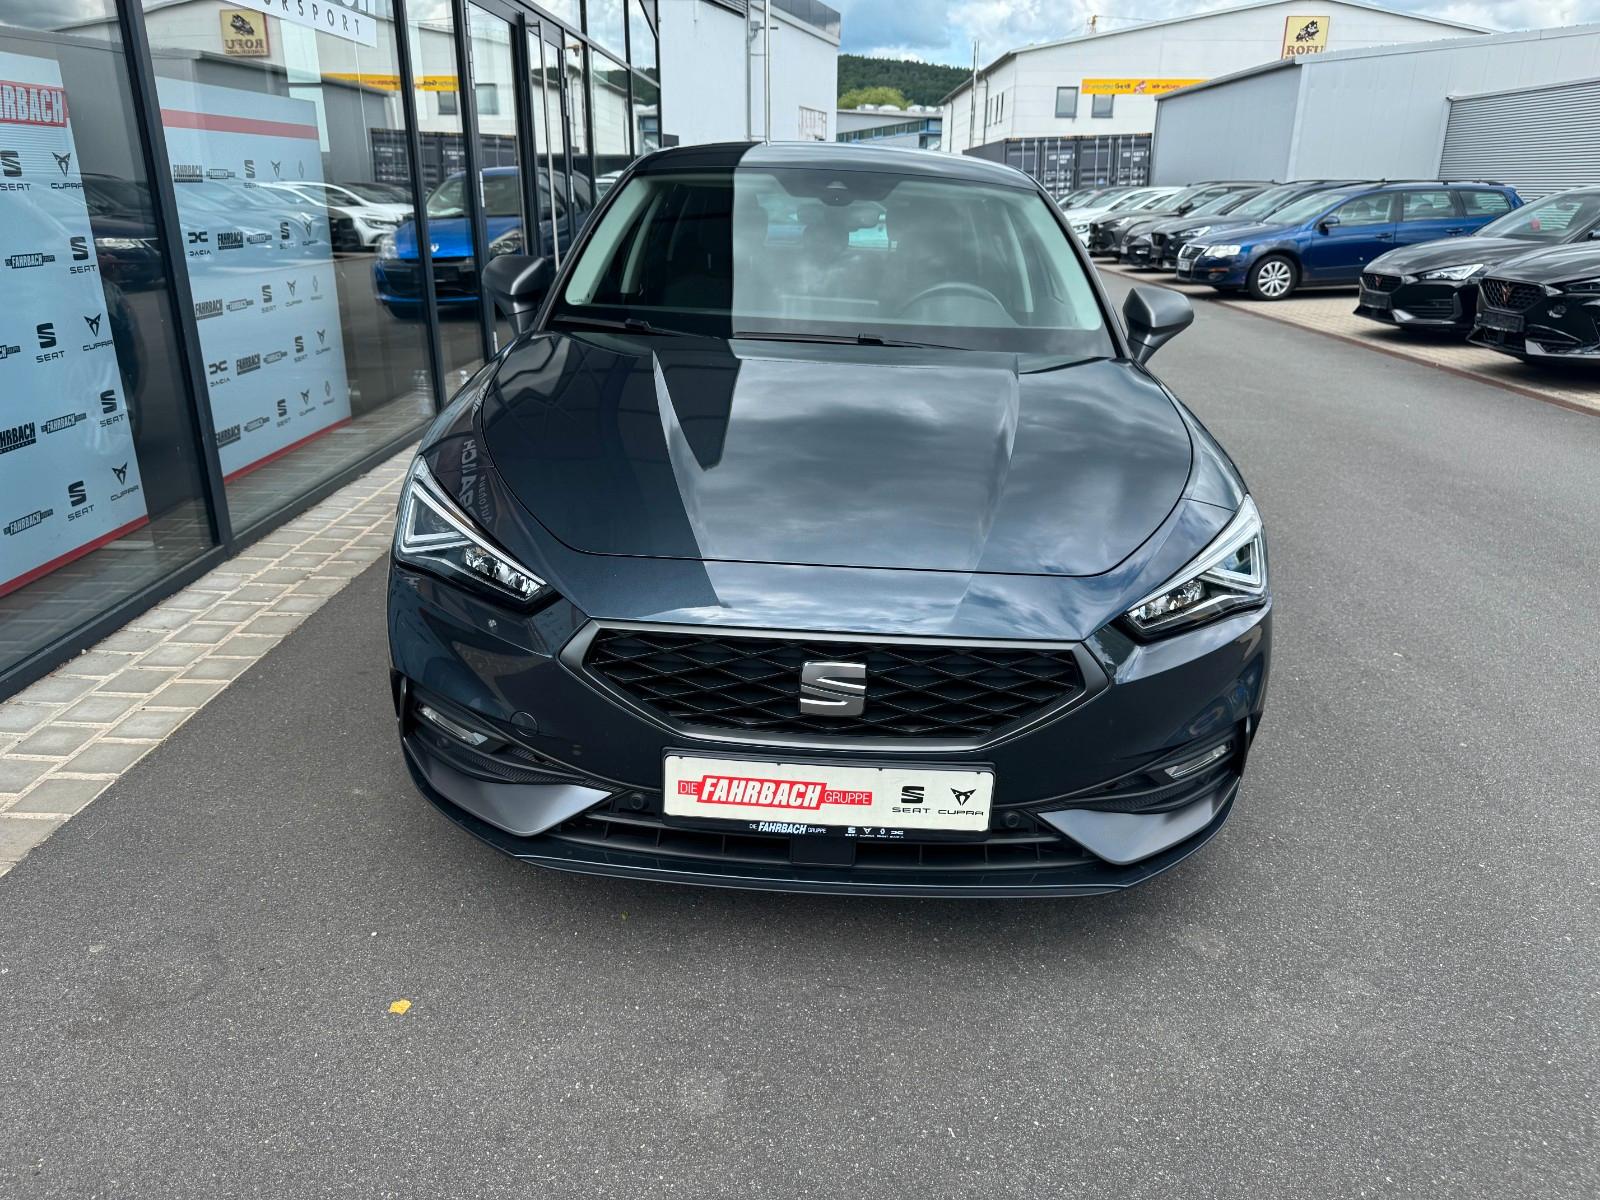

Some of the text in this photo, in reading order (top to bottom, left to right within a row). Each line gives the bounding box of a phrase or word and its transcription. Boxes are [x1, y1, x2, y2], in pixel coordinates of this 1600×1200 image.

[0, 84, 64, 123] RBACH
[0, 183, 31, 191] SEAT
[70, 264, 96, 274] SEAT
[83, 340, 114, 352] CUPRA
[36, 350, 65, 363] SEAT
[100, 414, 125, 428] SEAT
[110, 485, 140, 501] CUPRA
[68, 505, 95, 521] SEAT
[10, 511, 41, 535] FAHRBACH
[680, 778, 871, 807] DIE FAHRBACH GRUPPE
[758, 821, 808, 834] FAHRBACH
